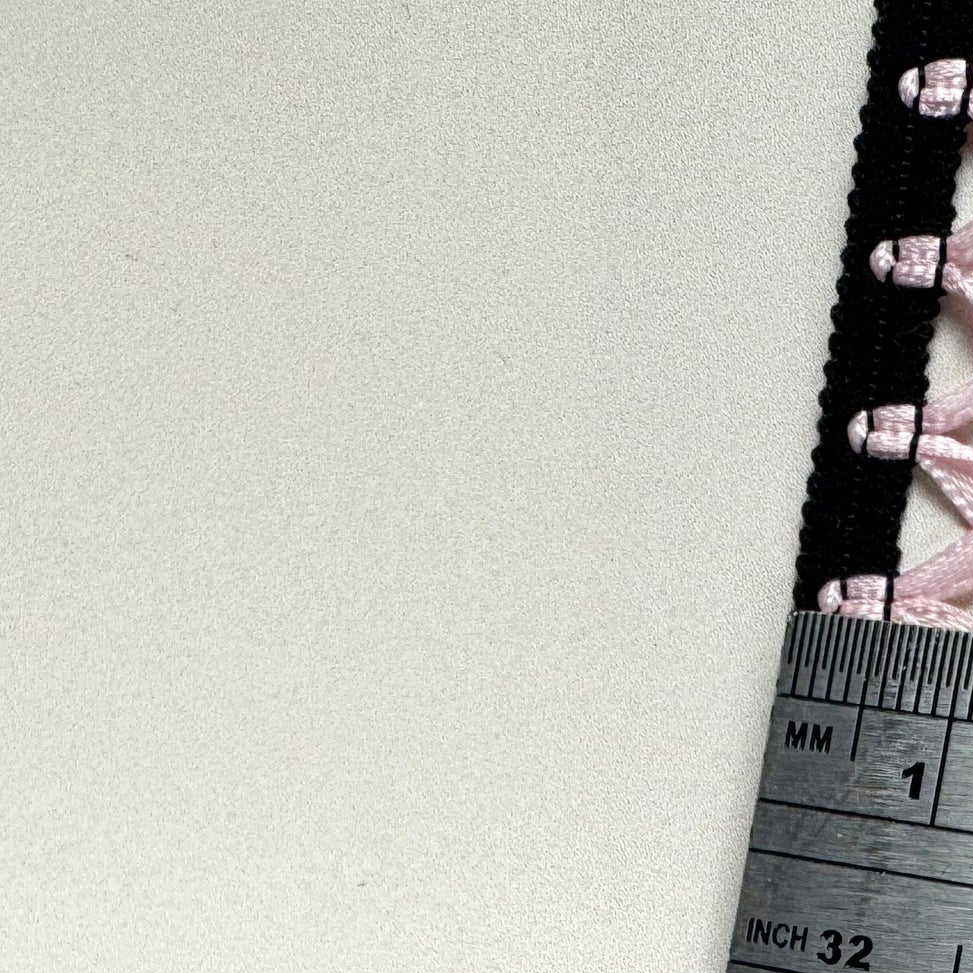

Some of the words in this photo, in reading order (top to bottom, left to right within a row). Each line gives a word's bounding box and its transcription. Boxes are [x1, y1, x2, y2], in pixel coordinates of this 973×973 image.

[785, 721, 833, 754] MM
[901, 762, 926, 800] 1
[746, 917, 808, 952] INCH
[816, 930, 874, 971] 32
